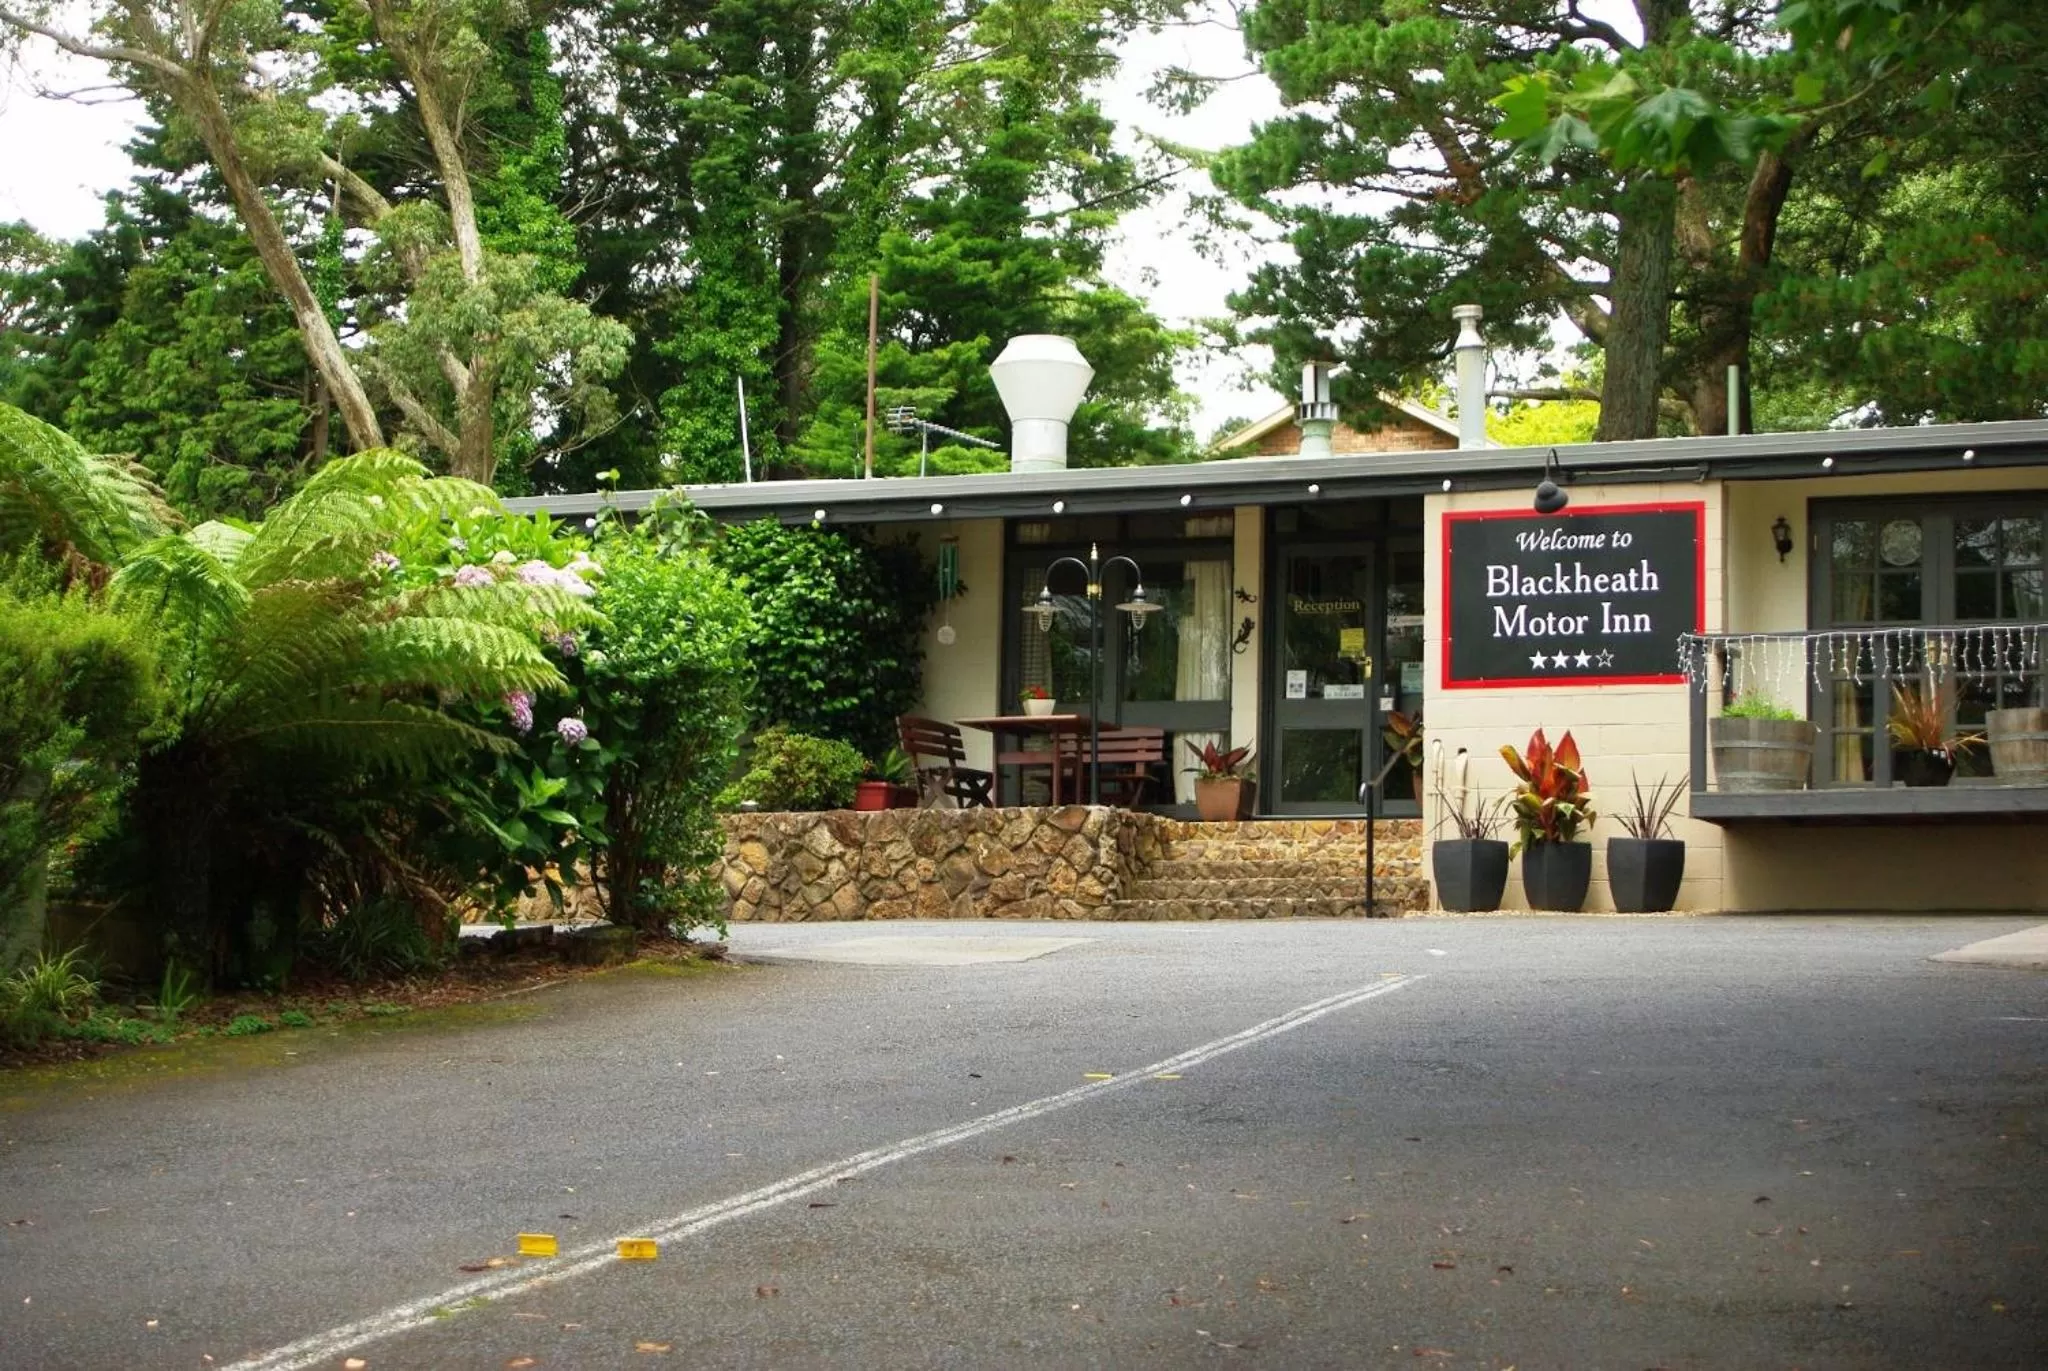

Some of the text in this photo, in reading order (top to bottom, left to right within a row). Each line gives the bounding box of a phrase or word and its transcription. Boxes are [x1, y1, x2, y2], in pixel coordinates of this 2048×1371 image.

[1516, 528, 1633, 551] Welcome to
[1486, 560, 1659, 597] Blackheath
[1294, 598, 1360, 614] Reception
[1493, 602, 1651, 637] Motor Inn
